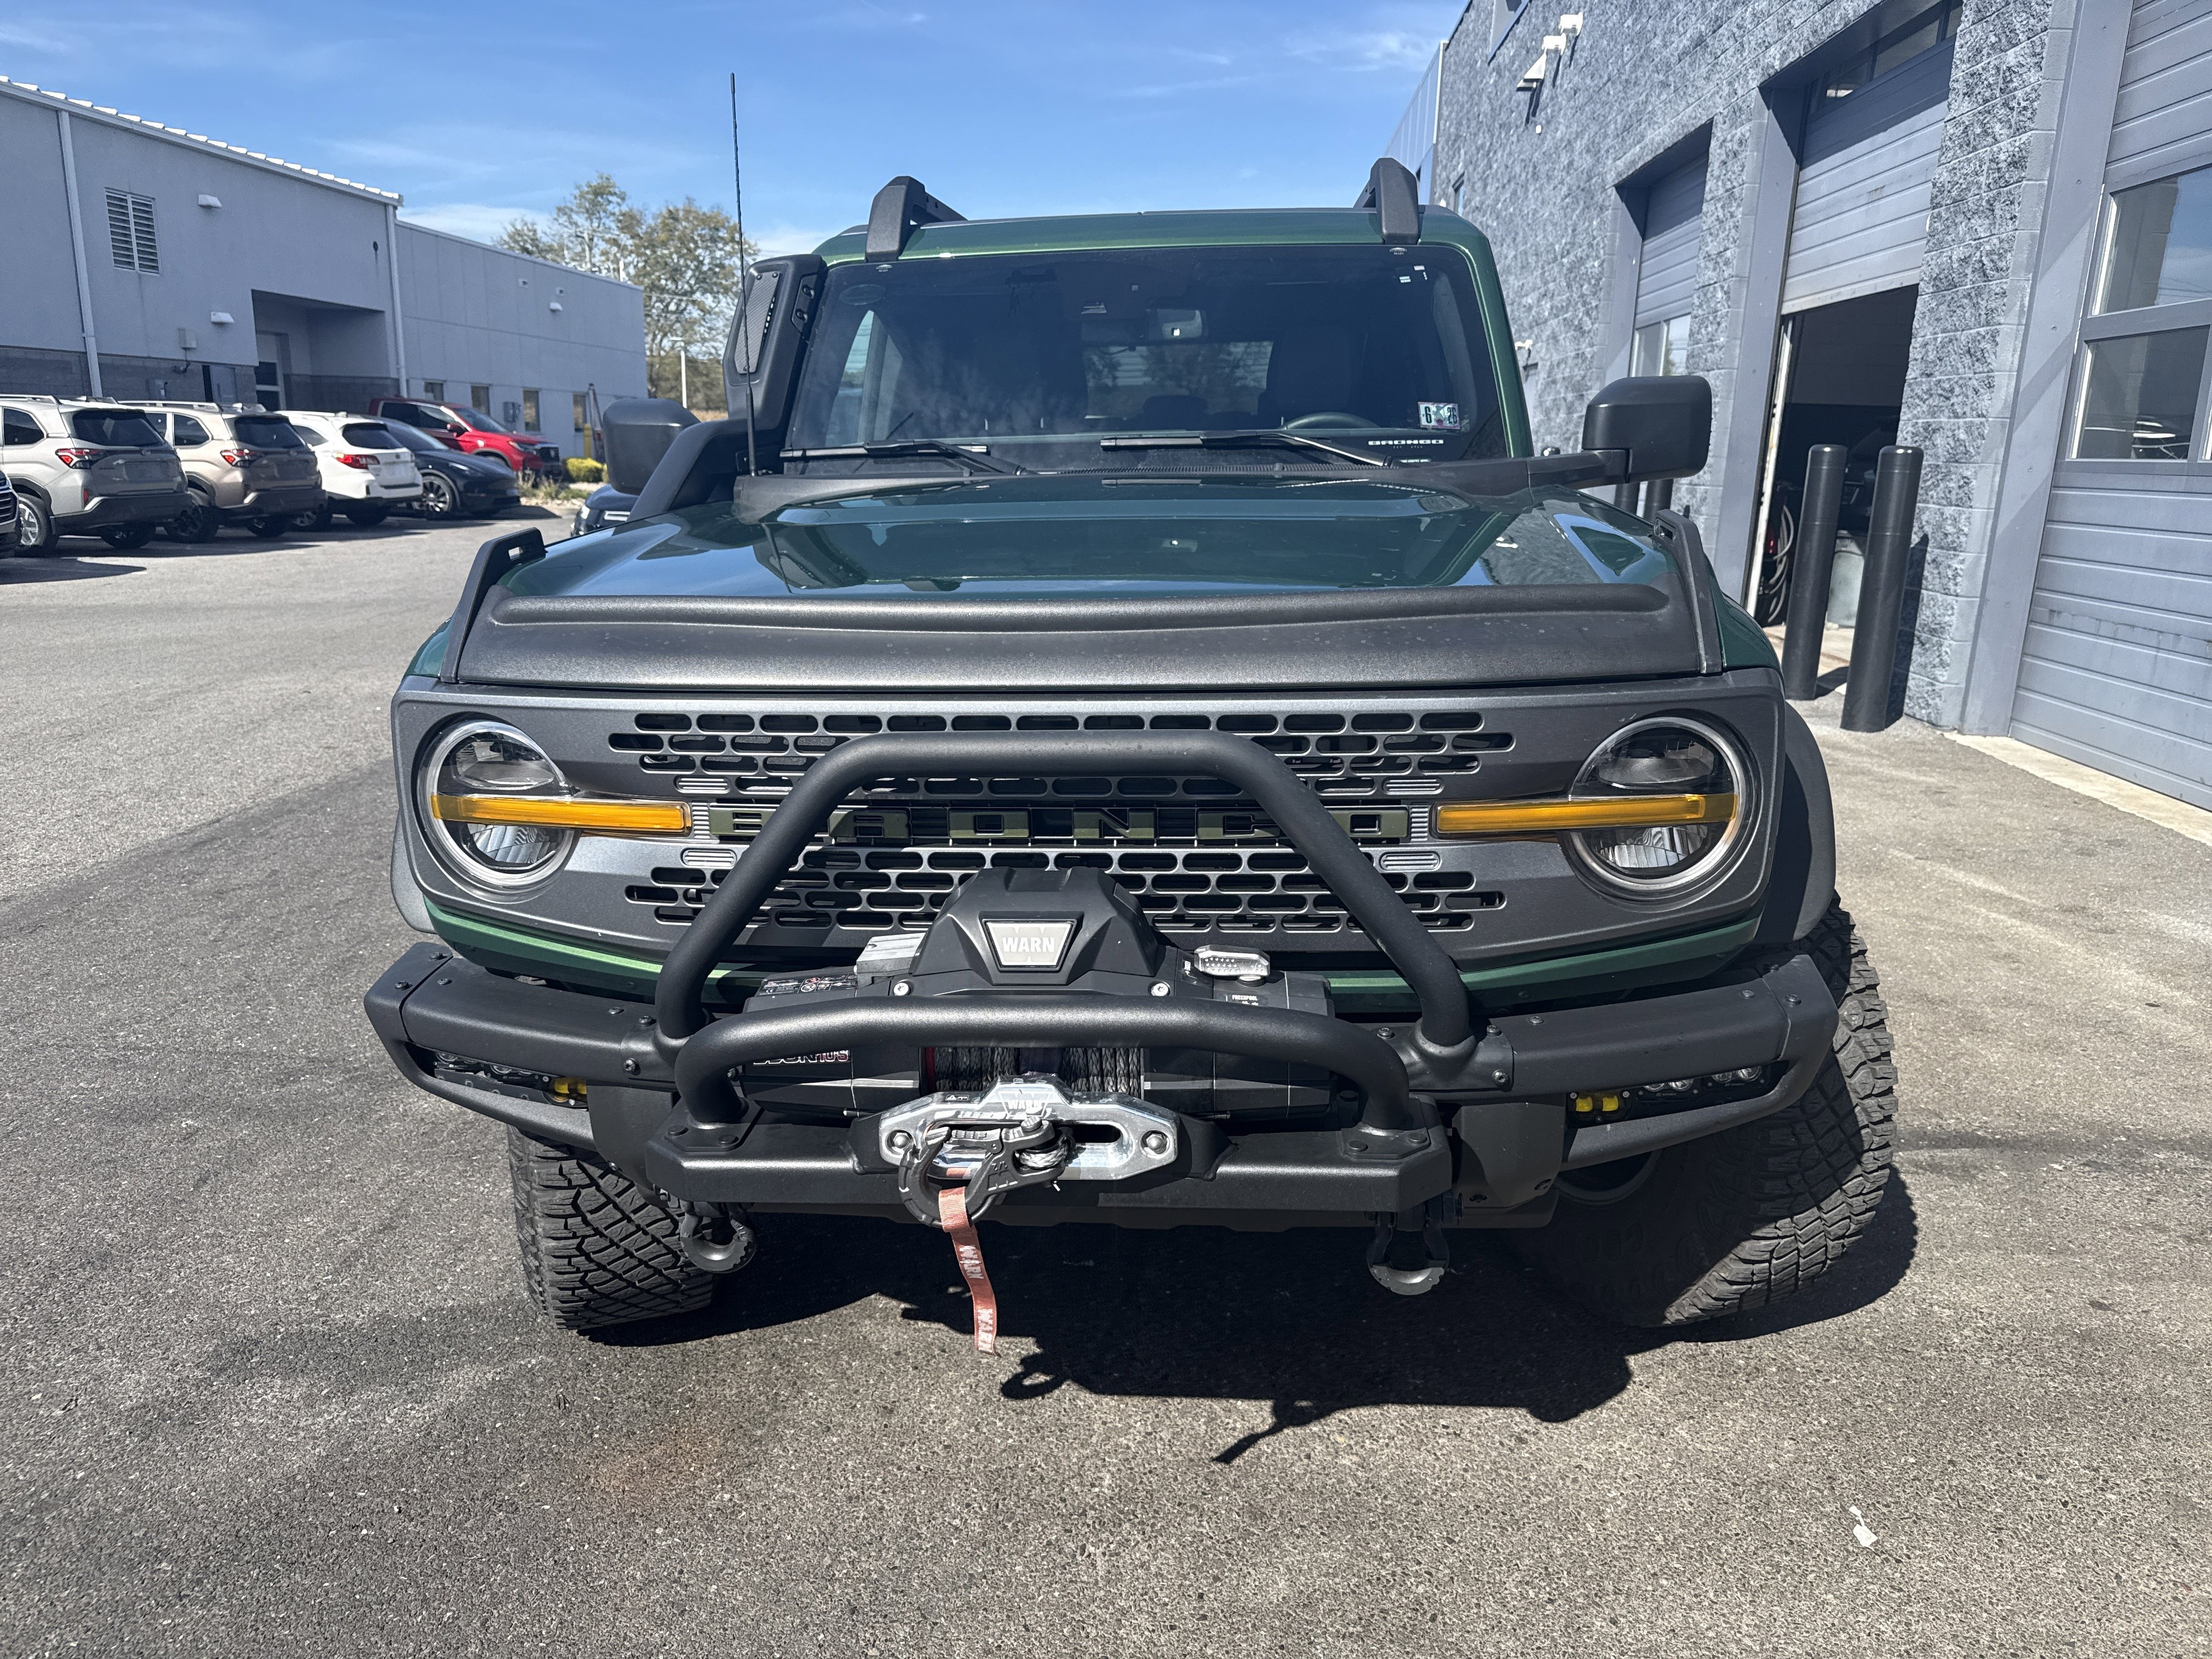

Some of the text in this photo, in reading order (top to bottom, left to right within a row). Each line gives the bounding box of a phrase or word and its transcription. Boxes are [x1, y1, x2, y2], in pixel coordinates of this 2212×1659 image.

[1424, 406, 1458, 424] 6 26
[1002, 937, 1054, 952] WARN
[1007, 1099, 1043, 1110] WARN
